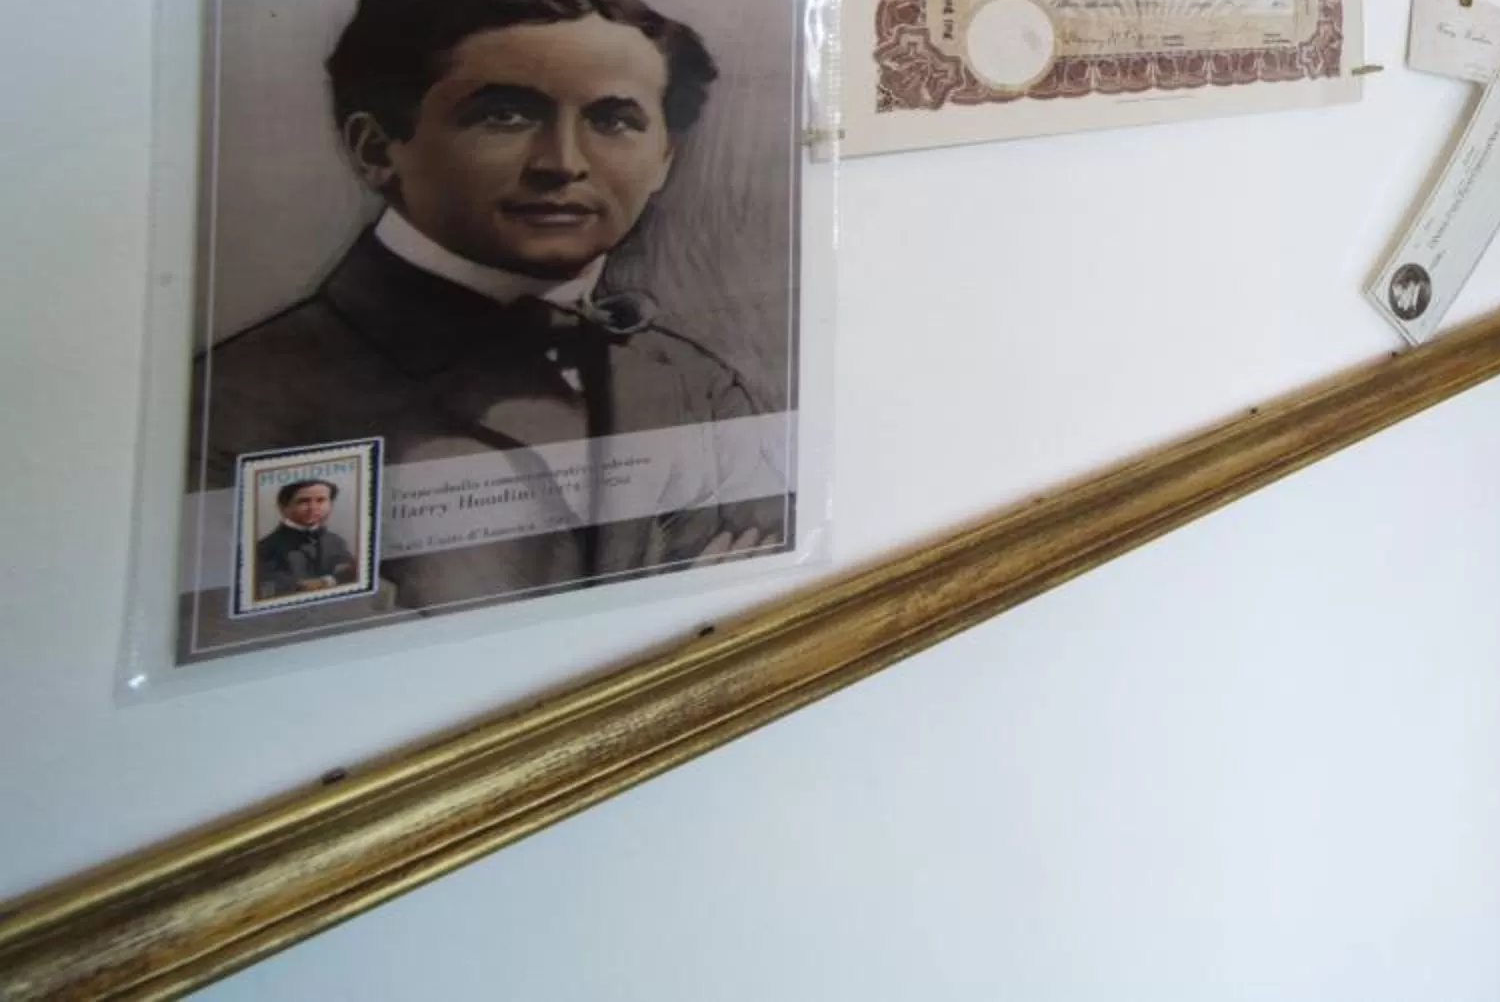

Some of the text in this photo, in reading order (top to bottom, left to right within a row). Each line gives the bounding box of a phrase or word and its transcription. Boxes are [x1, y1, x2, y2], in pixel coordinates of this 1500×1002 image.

[260, 463, 355, 485] HOUDINI
[391, 503, 449, 521] Harry
[459, 488, 536, 510] Houdini
